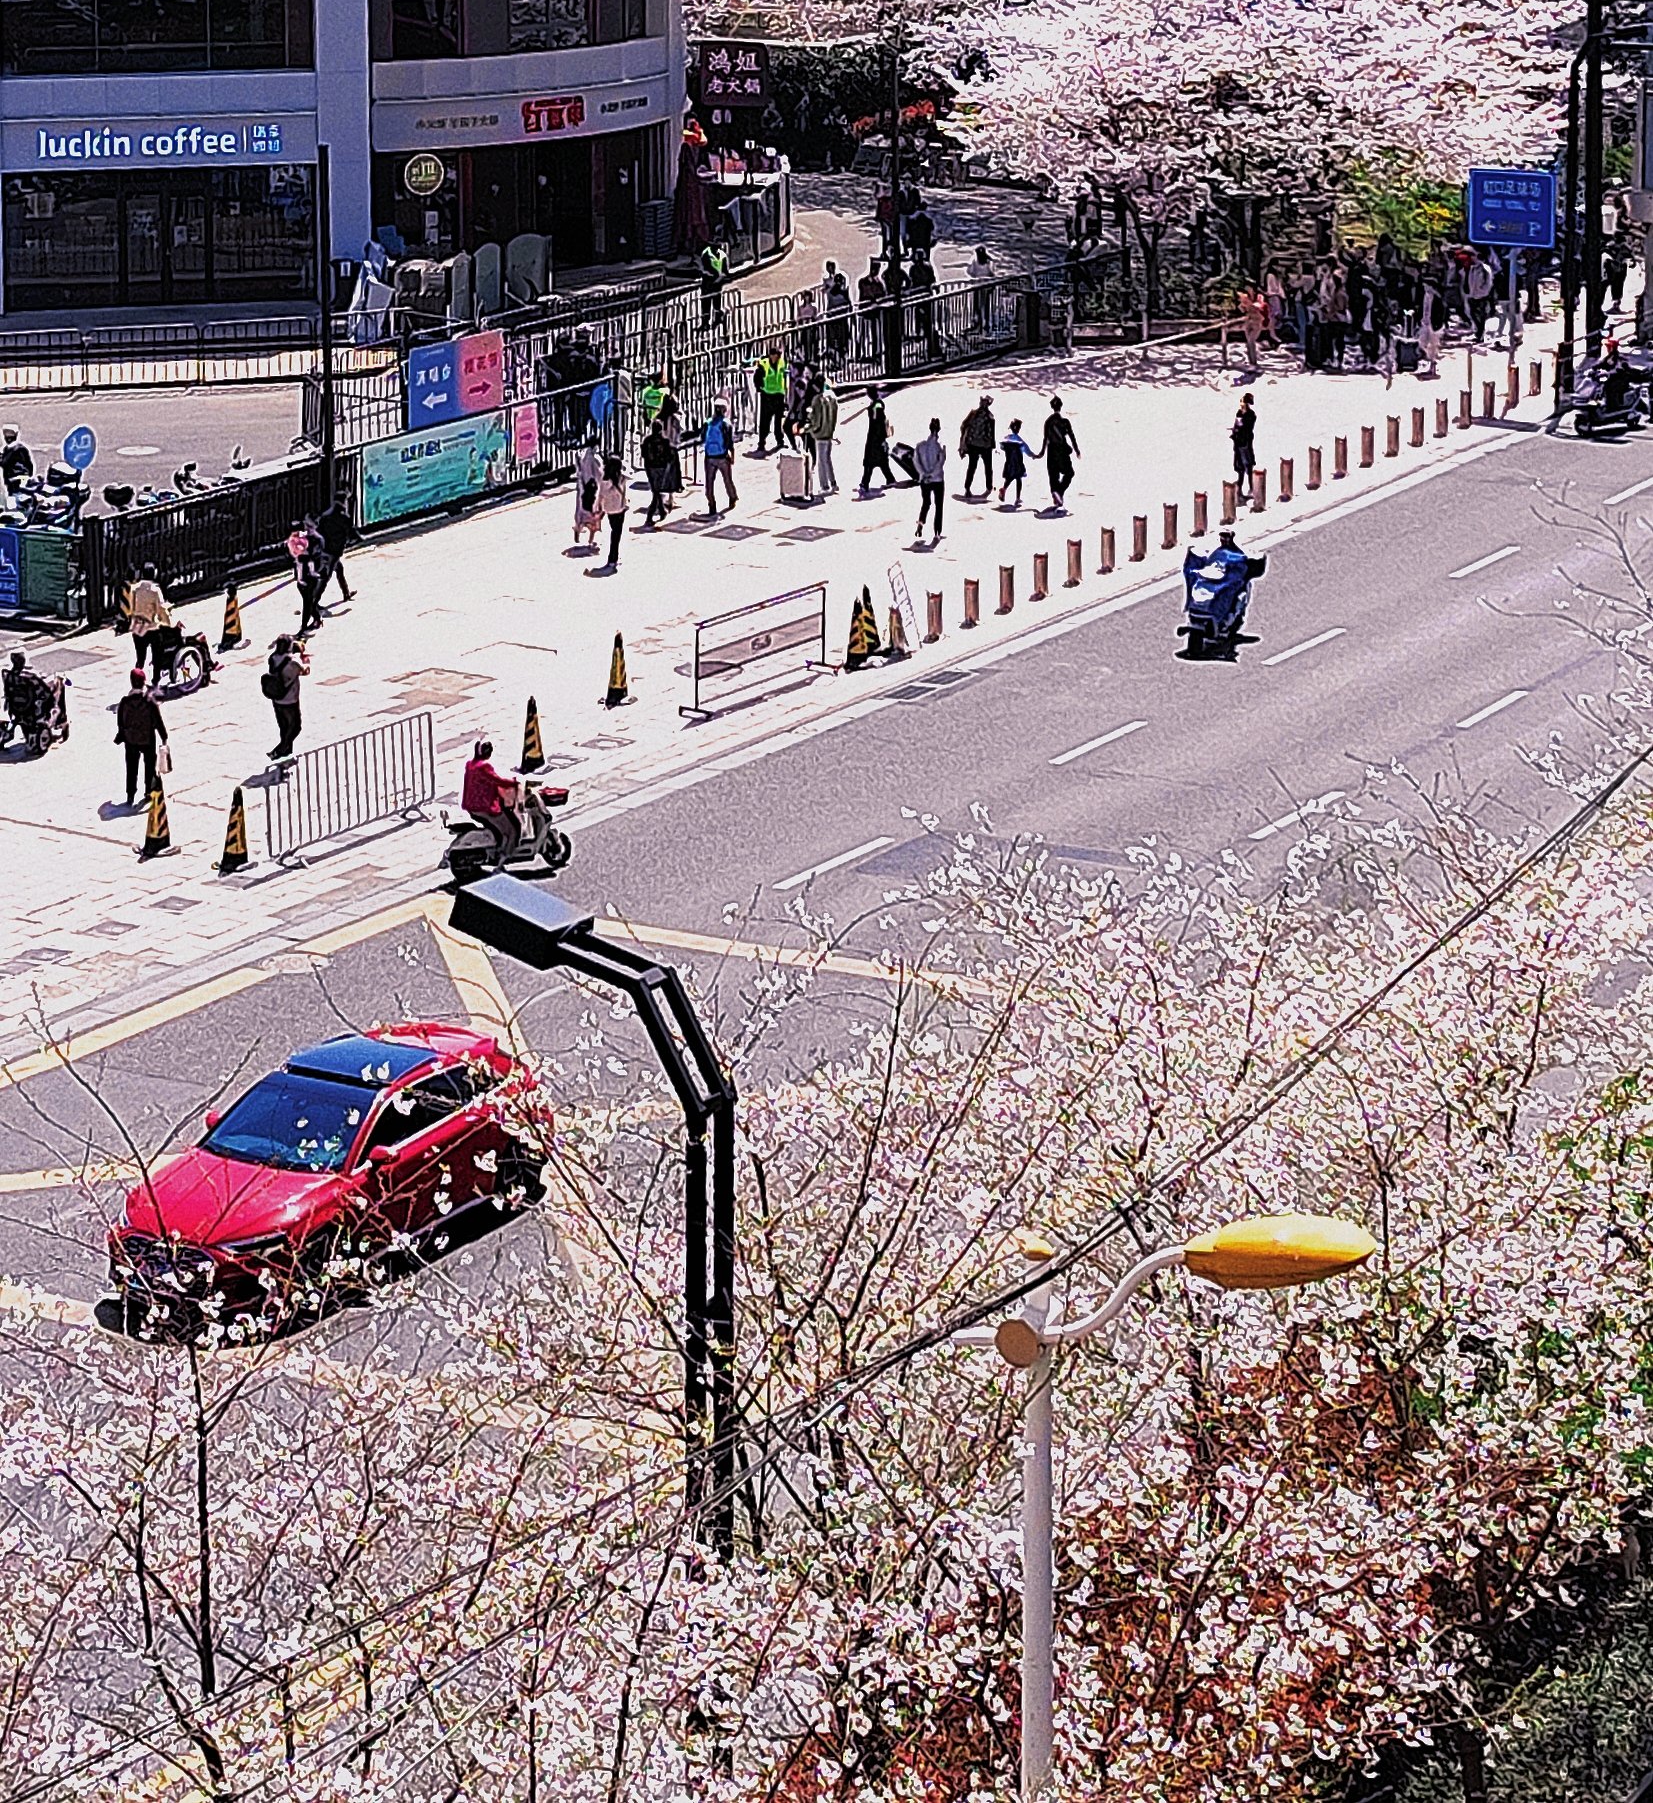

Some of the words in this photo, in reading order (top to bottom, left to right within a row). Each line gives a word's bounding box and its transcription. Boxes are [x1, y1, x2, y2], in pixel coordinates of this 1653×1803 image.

[708, 48, 761, 74] 鸿姐
[38, 127, 131, 159] luckin
[141, 127, 236, 156] coffee
[1528, 221, 1541, 237] P
